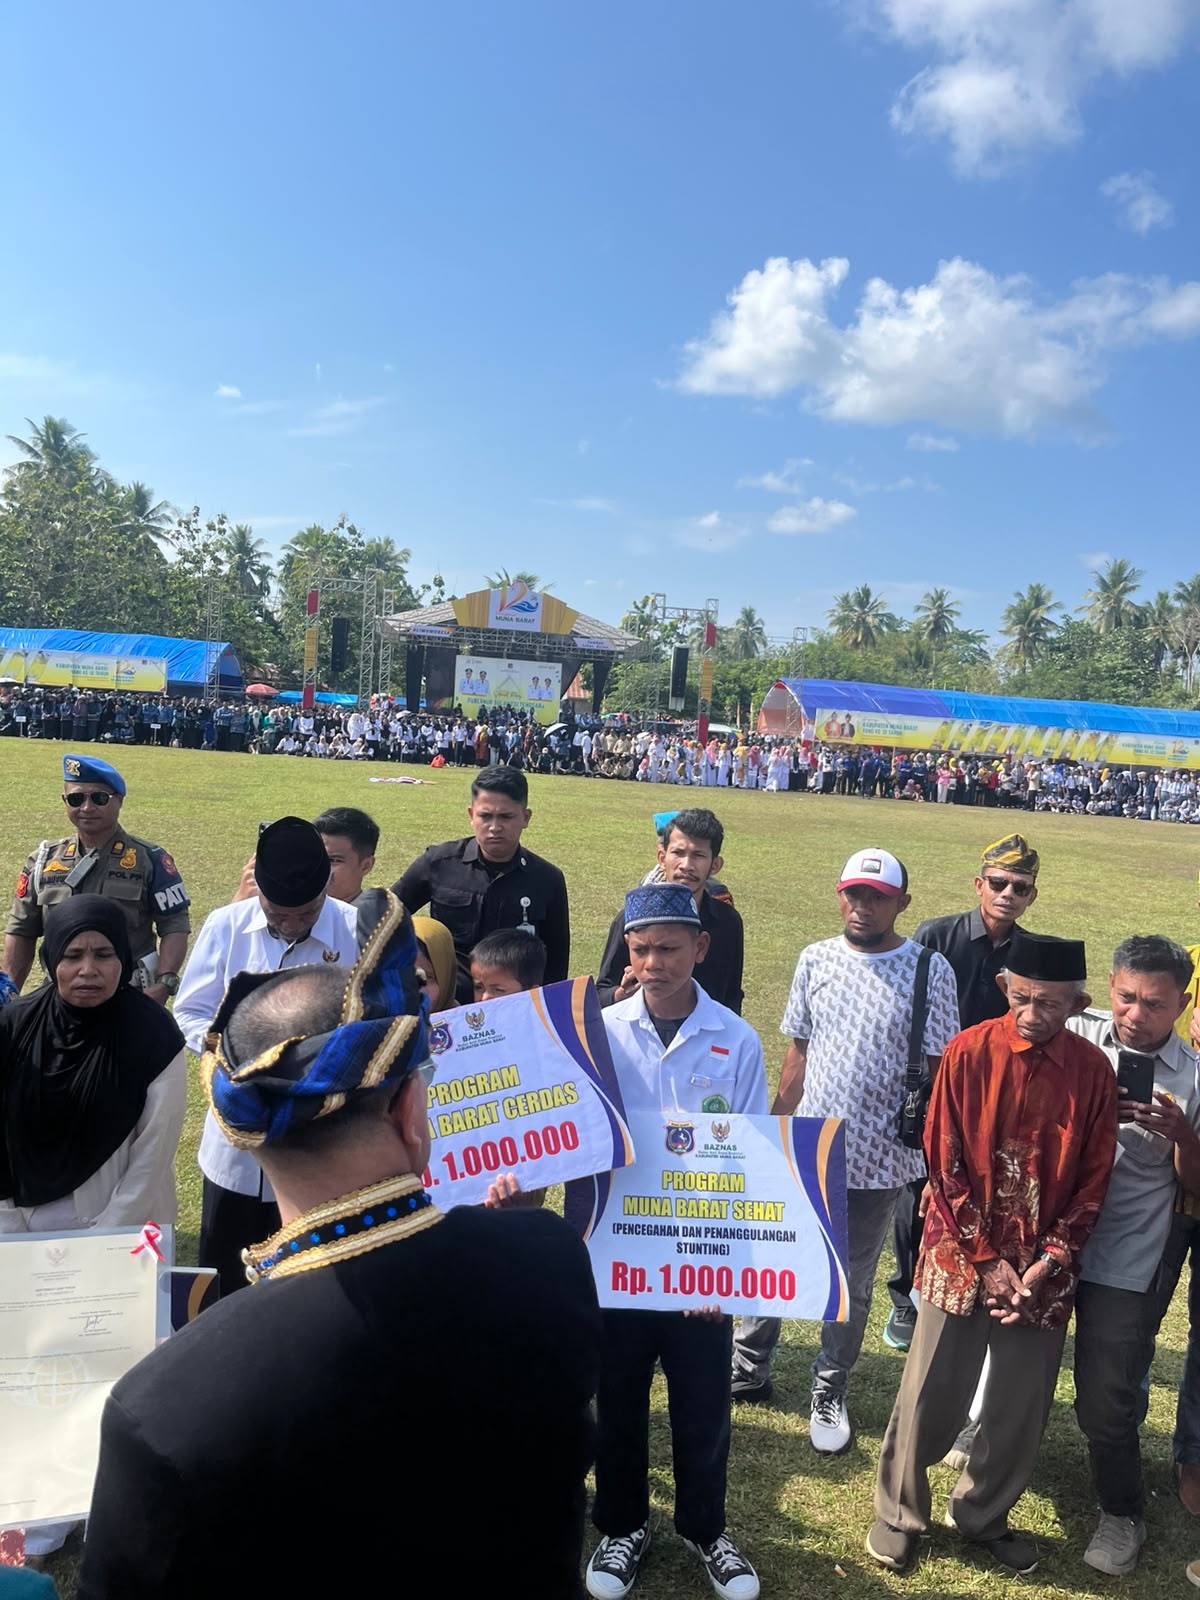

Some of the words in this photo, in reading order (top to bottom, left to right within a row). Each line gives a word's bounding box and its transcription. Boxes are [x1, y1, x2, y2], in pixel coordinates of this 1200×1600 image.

[495, 615, 514, 623] MUNA
[108, 871, 129, 879] POL
[130, 872, 143, 880] PP
[462, 1028, 496, 1043] BAZNAS
[427, 1064, 521, 1108] PROGRAM
[438, 1100, 500, 1137] BARAT
[502, 1081, 579, 1121] CERDAS
[442, 1120, 580, 1182] 1.000.000
[704, 1144, 737, 1152] BAZNAS
[662, 1170, 746, 1193] PROGRAM
[623, 1196, 672, 1217] MUNA
[675, 1198, 730, 1220] BARAT
[732, 1200, 785, 1222] SEHAT
[612, 1222, 680, 1238] (PENCEGAHAN
[682, 1226, 703, 1238] DAN
[704, 1227, 796, 1242] PENANGGULANGAN
[676, 1242, 730, 1256] STUNTING)
[612, 1262, 652, 1296] Rp.
[658, 1264, 796, 1301] 1.000.000
